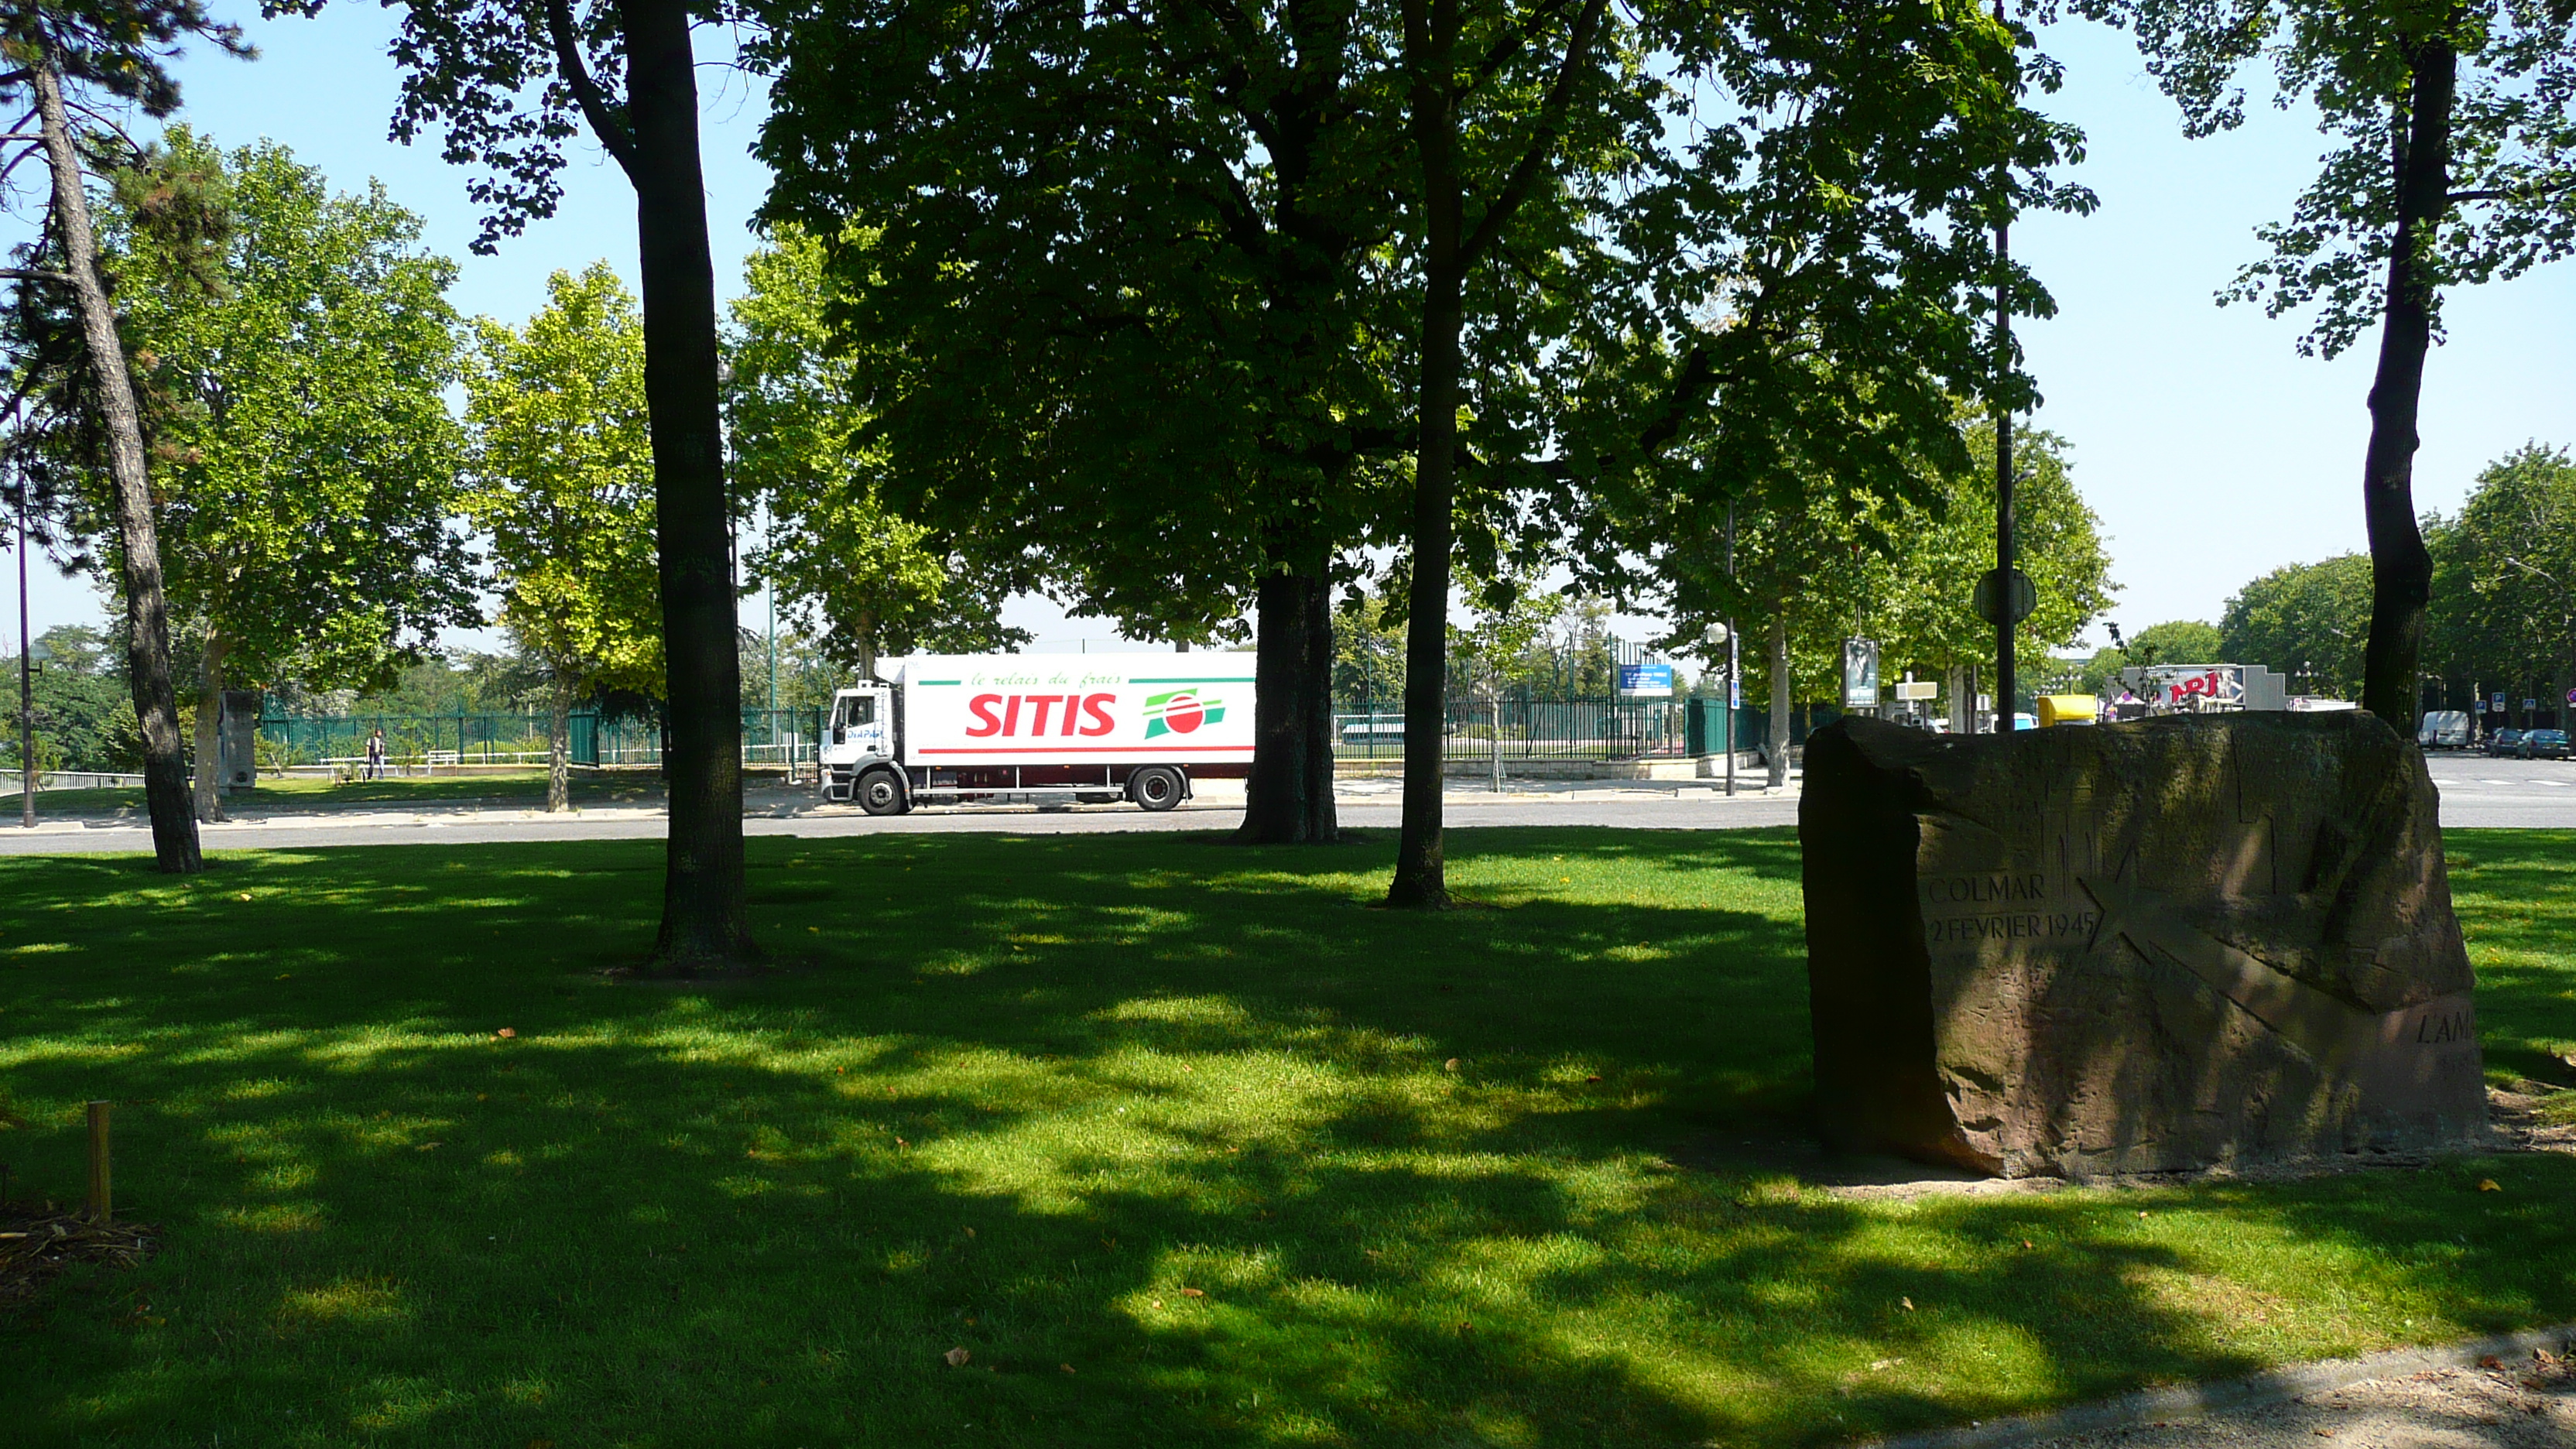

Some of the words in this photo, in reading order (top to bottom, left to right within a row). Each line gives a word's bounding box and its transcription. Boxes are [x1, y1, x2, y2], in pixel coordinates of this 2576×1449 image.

[971, 672, 985, 687] le
[993, 672, 1039, 687] relais
[1048, 671, 1070, 686] du
[1079, 672, 1122, 689] frais
[965, 693, 1116, 737] SITIS
[1928, 874, 2045, 904] COLMAR
[2048, 912, 2095, 937] 1945
